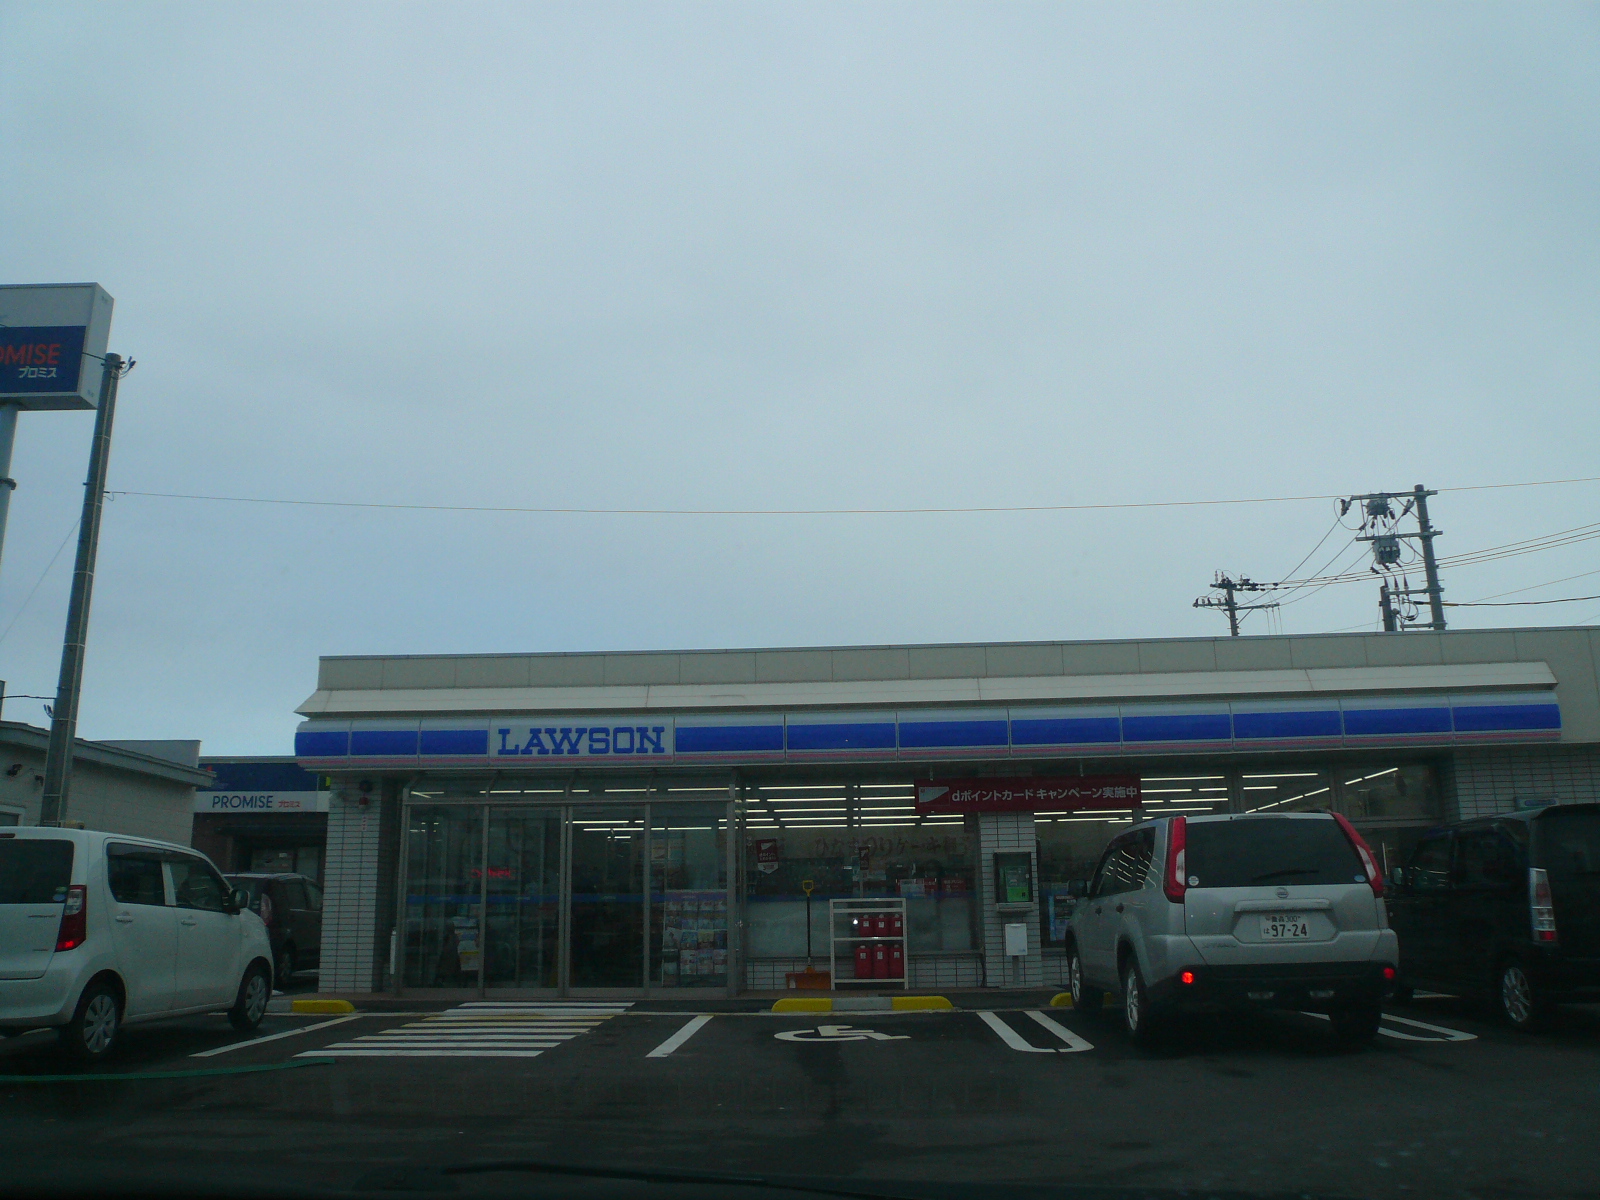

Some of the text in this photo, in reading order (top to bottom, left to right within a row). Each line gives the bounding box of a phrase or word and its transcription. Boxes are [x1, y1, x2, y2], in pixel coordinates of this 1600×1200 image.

[0, 343, 61, 365] MISE
[18, 366, 57, 378] プロミス
[497, 726, 665, 755] LAWSON
[951, 785, 1138, 802] dポイントカード キャンペーン実施中
[212, 795, 301, 808] PROMISE プロミス
[1285, 915, 1298, 923] 300
[1271, 923, 1307, 937] 97-24
